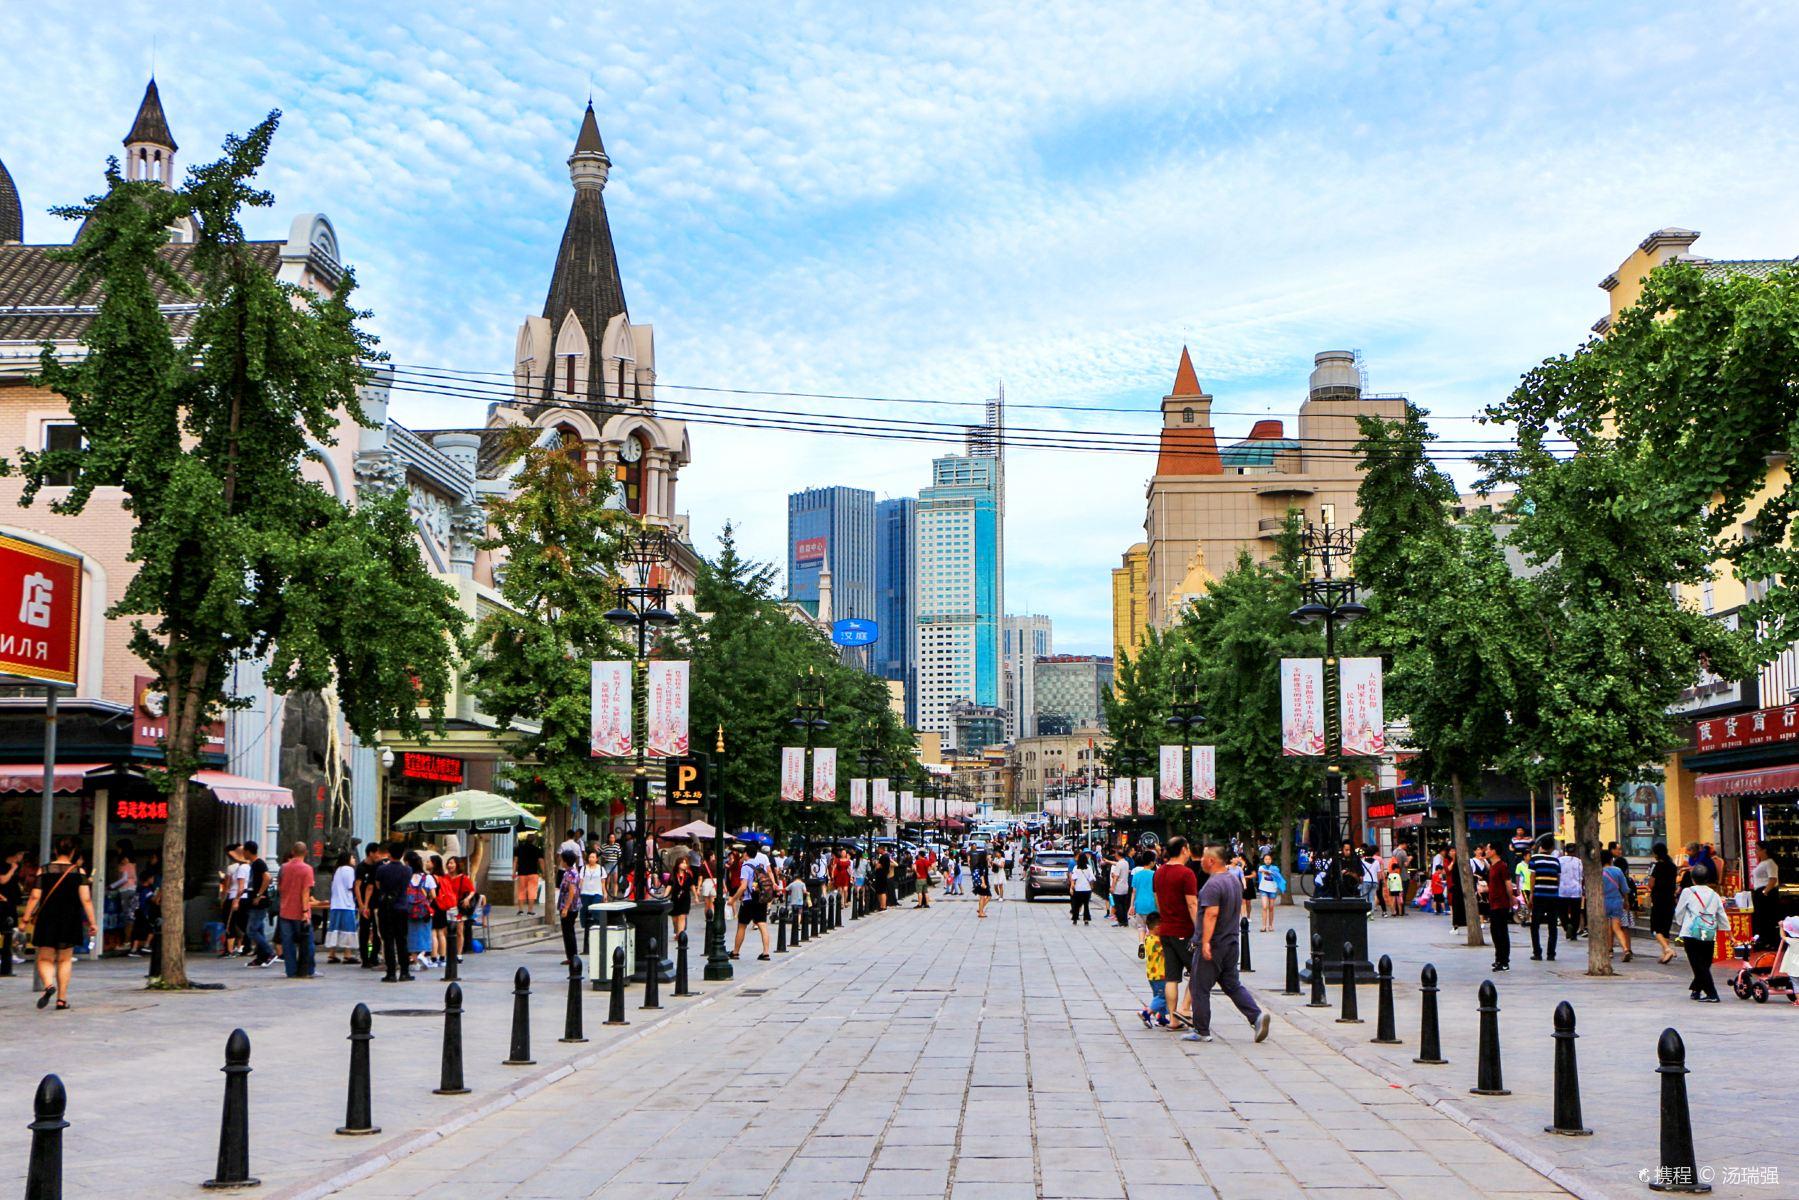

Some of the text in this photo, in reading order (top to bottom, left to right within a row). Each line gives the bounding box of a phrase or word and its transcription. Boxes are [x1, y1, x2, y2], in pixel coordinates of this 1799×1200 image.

[18, 571, 54, 629] 店
[841, 631, 868, 641] 汉庭
[1368, 672, 1377, 708] 人民有信仰
[679, 765, 697, 790] P
[672, 791, 703, 799] 停车场
